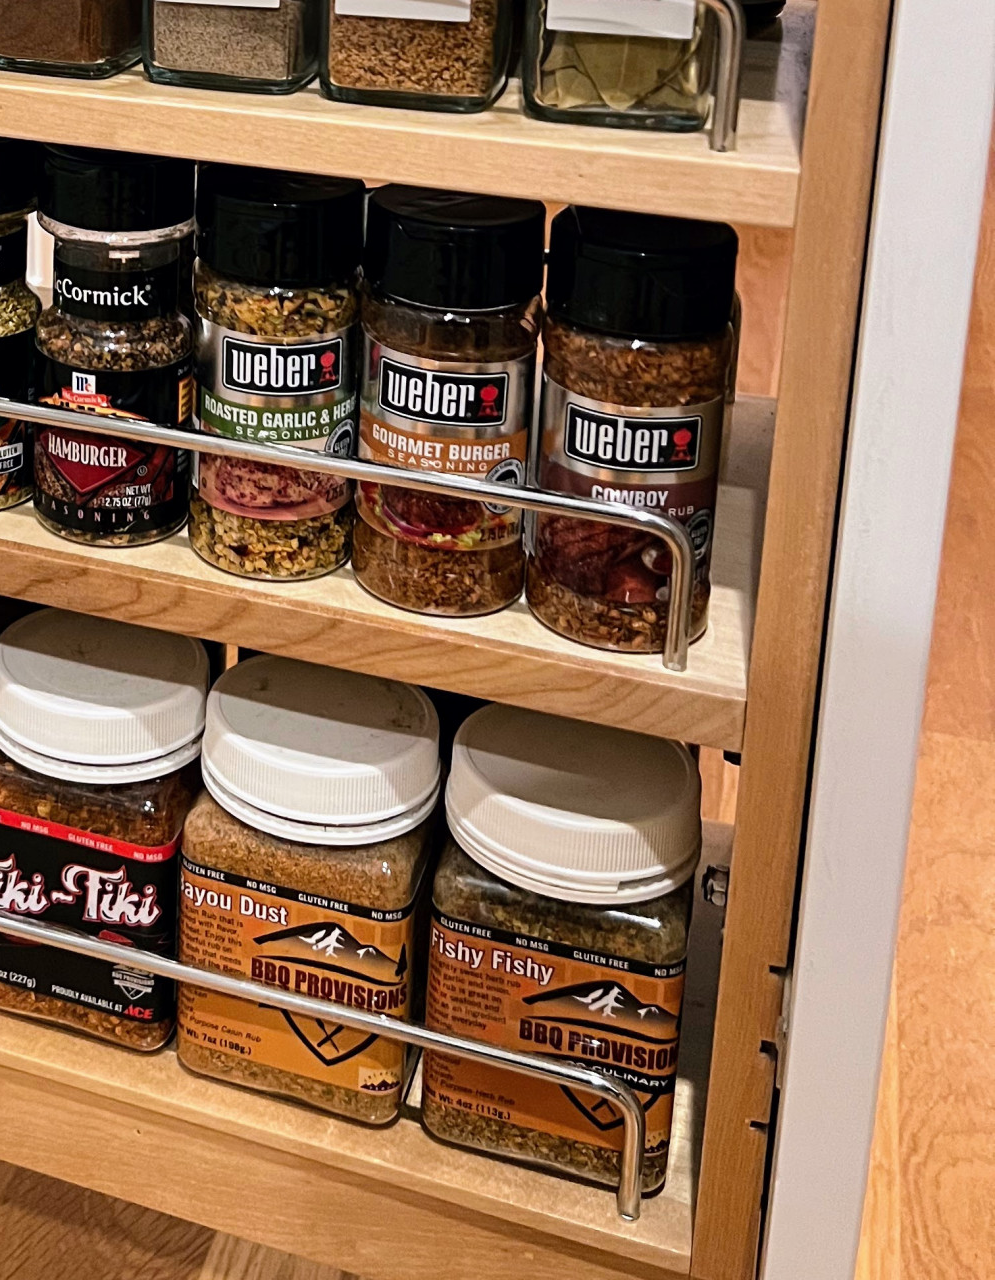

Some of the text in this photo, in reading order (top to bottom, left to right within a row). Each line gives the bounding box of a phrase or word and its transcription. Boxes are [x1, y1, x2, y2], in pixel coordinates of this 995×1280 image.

[232, 344, 316, 388] weber
[205, 395, 258, 426] ROASTED
[262, 411, 316, 428] GARLIC
[320, 409, 330, 424] &
[387, 370, 475, 418] weber
[48, 432, 127, 468] HAMBURGER
[373, 424, 444, 458] GOURMET
[449, 443, 510, 461] BURGER
[574, 416, 668, 463] weber
[388, 449, 488, 471] SEASONING
[105, 497, 132, 507] 2.75 OZ
[125, 483, 152, 496] NET WT
[592, 485, 669, 507] COWBOY
[668, 506, 695, 517] RUB
[33, 824, 163, 861] MSG GLUTEN FREE MSG
[207, 869, 403, 921] FREE NO MSG GLUTEN FREE NO MSG
[240, 894, 288, 926] Dust
[432, 928, 554, 986] Fishy Fishy
[440, 917, 667, 977] GLUTEN FREE NO MSG GLUTEN FREE NO
[9, 971, 36, 988] (227g)
[251, 957, 290, 986] BBQ
[295, 970, 406, 1011] PROVISIONS
[52, 984, 154, 1019] PROUDLY AVAILABLE AT ACE
[519, 1020, 563, 1051] BBQ
[456, 1099, 473, 1110] 4oz
